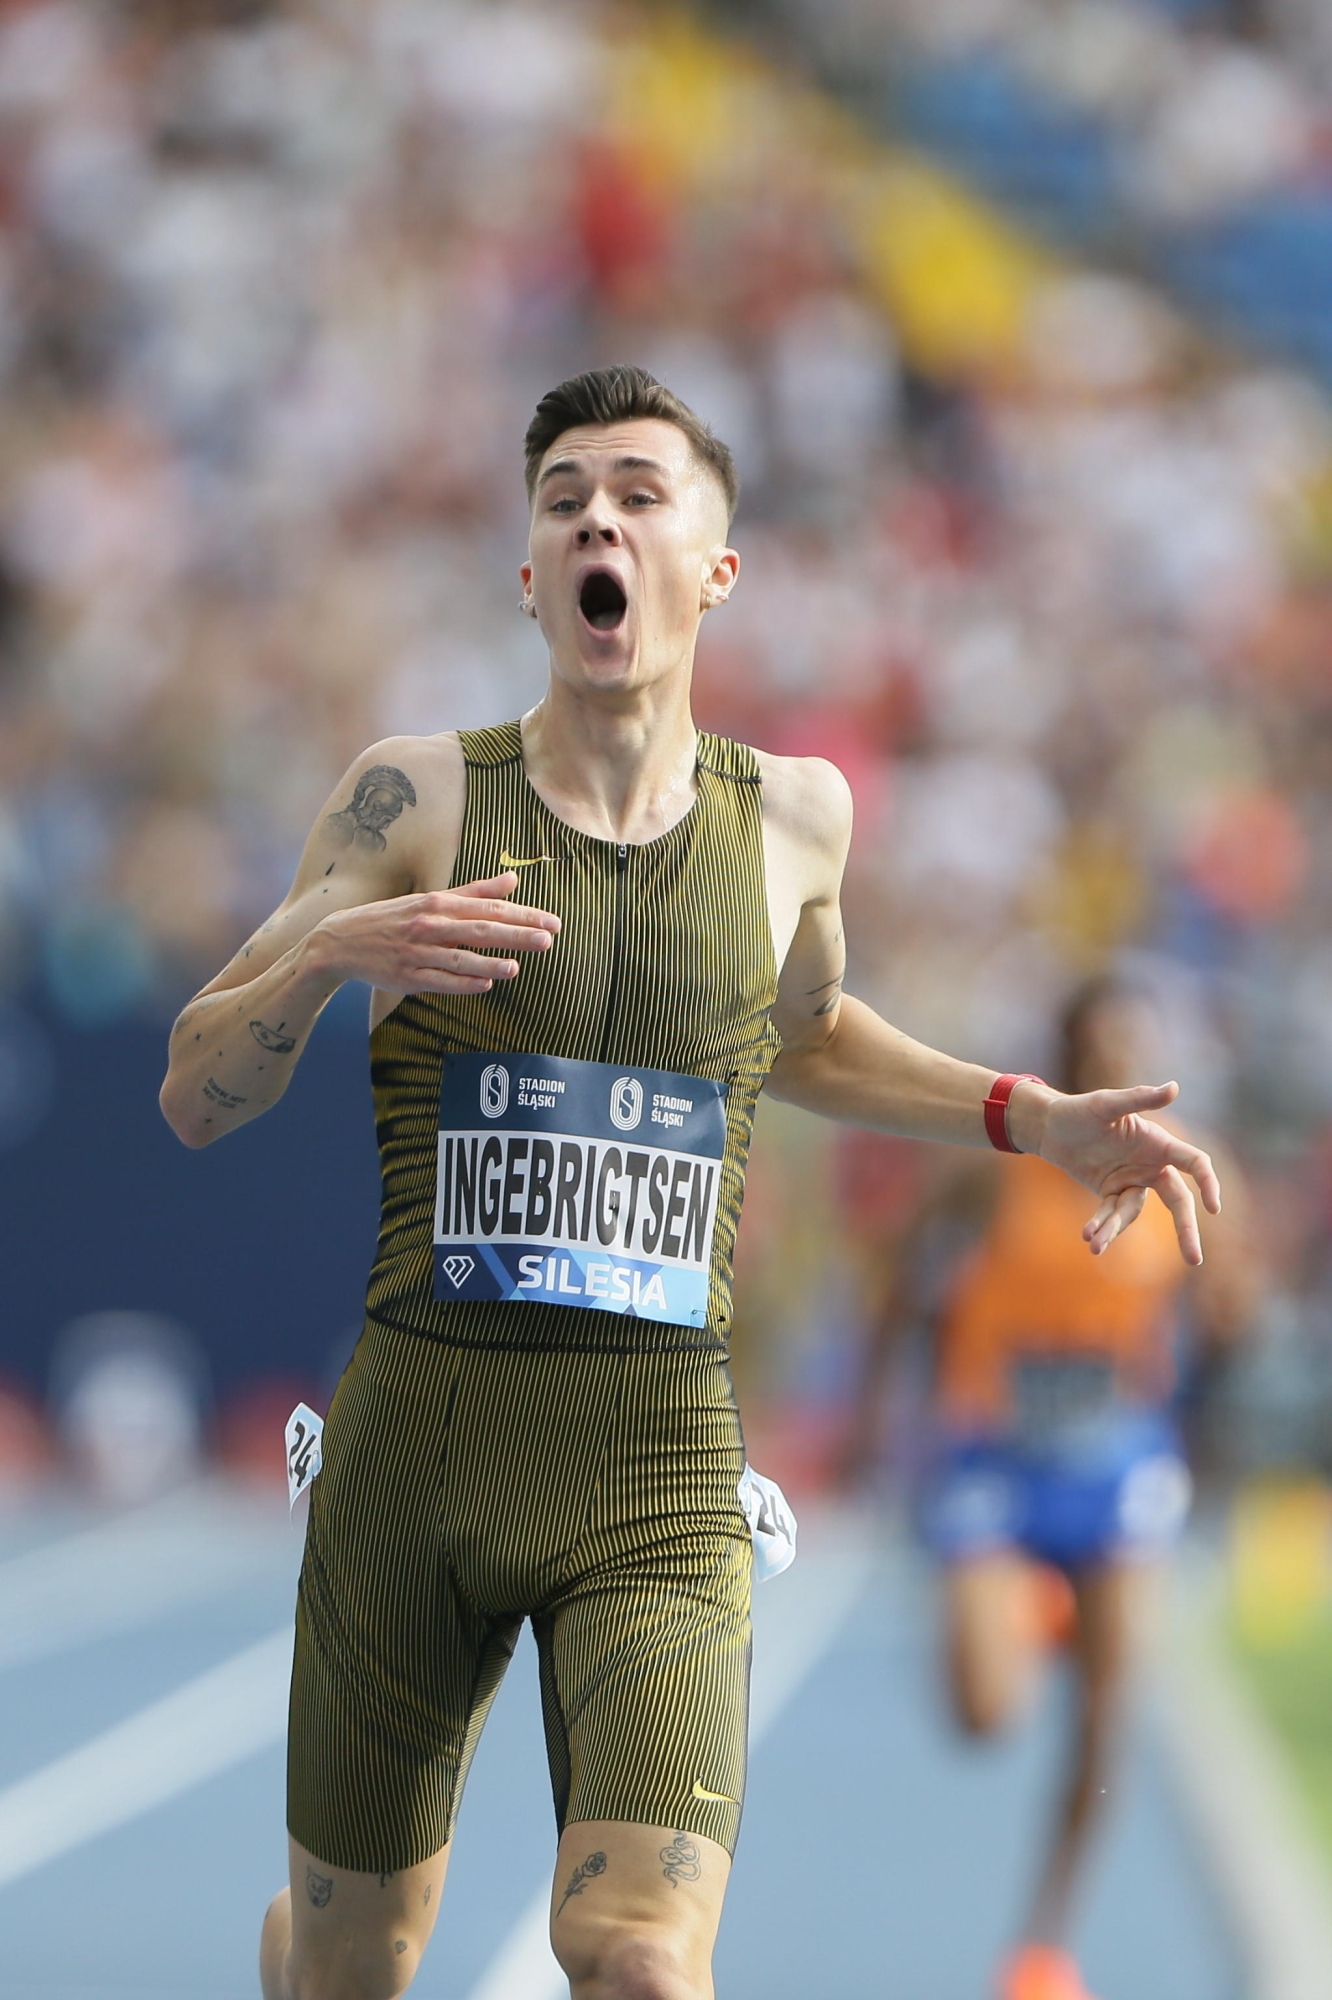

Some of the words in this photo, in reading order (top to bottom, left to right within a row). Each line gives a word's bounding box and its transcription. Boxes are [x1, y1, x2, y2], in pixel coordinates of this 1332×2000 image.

[518, 1077, 566, 1094] STADION
[517, 1093, 556, 1111] ŚLĄSKI
[652, 1094, 693, 1113] STADION
[651, 1110, 684, 1129] ŚLĄSKI
[442, 1136, 714, 1262] INGEBRIGTSEN
[517, 1255, 667, 1311] SILESIA
[289, 1421, 317, 1488] 24
